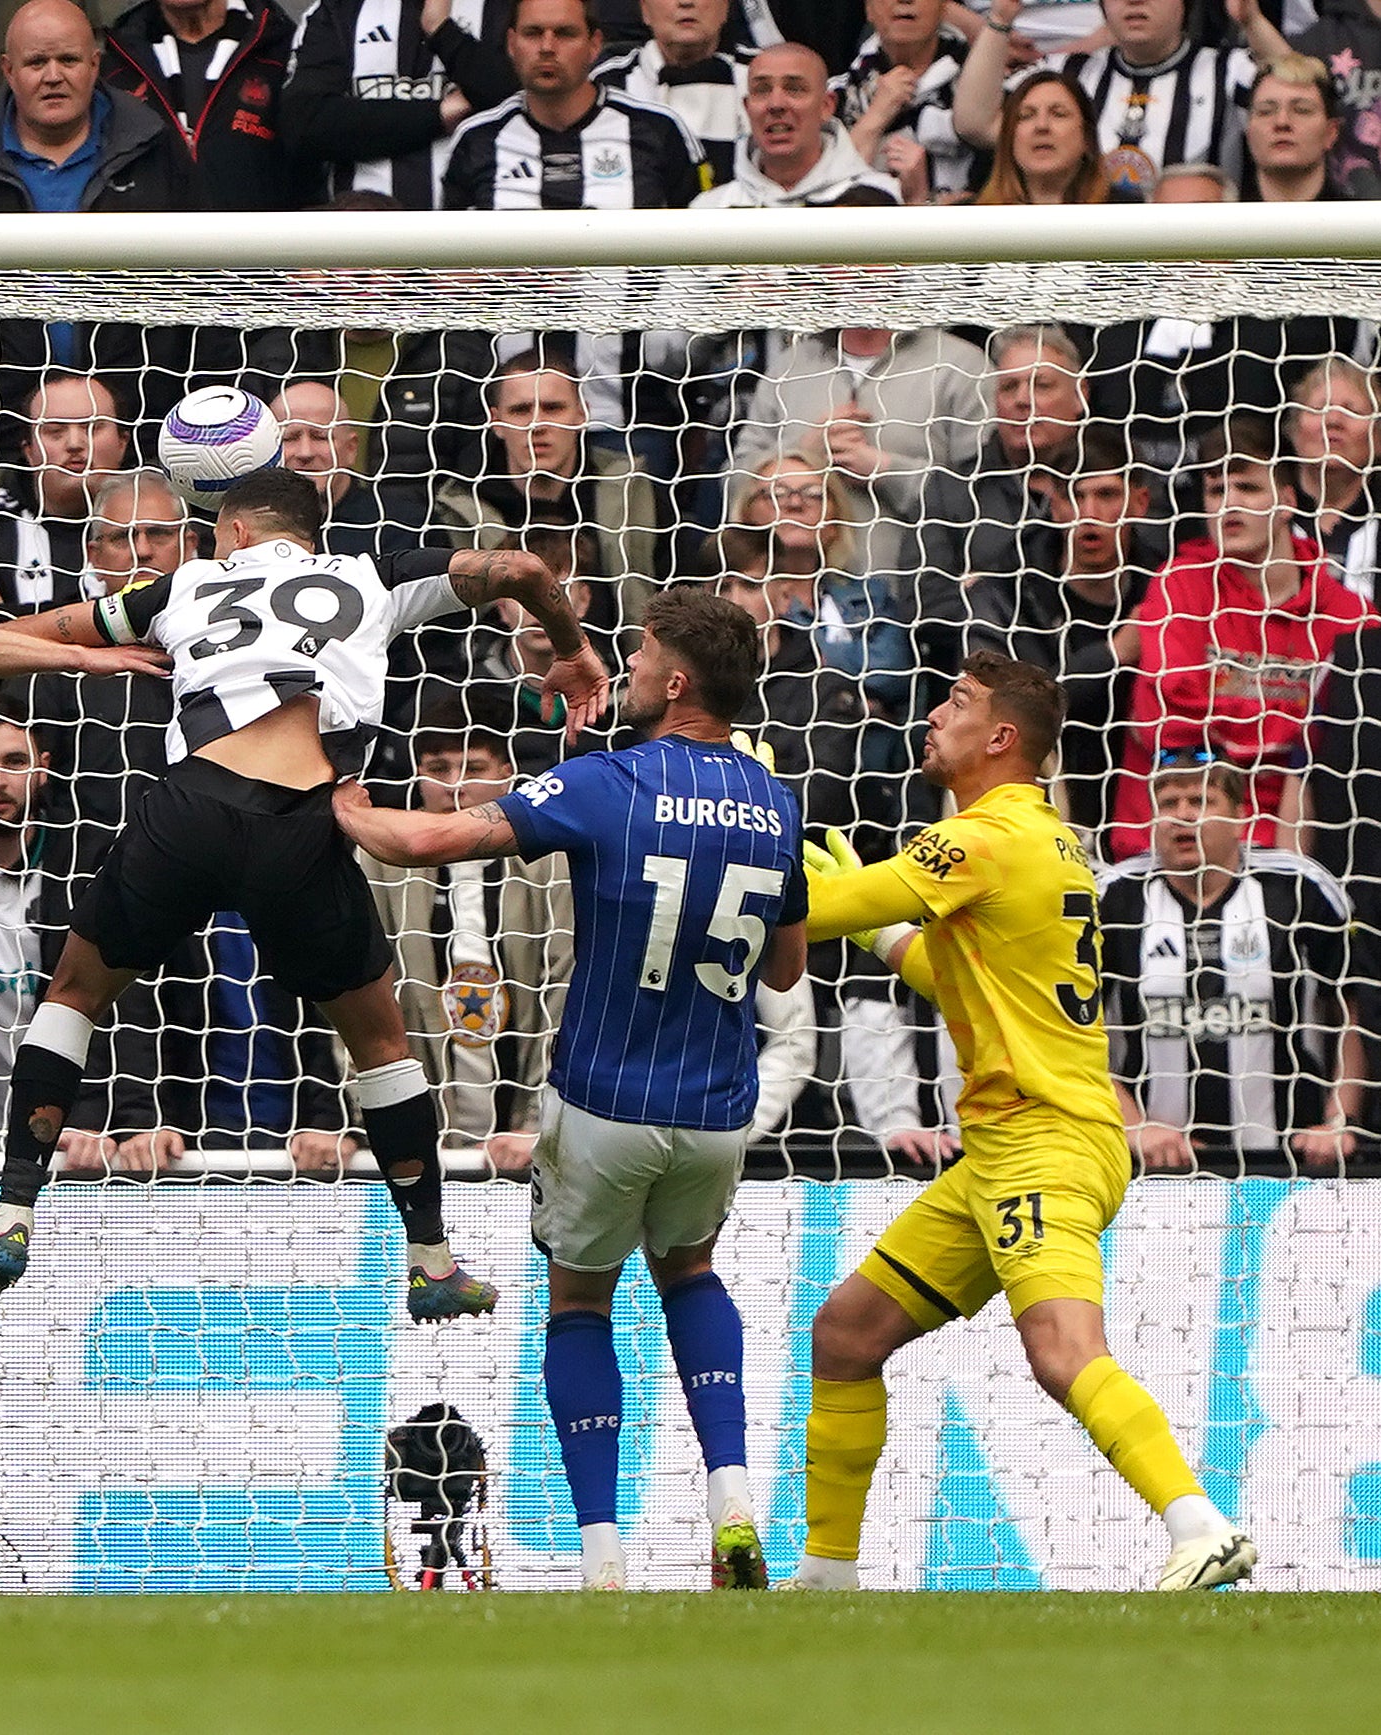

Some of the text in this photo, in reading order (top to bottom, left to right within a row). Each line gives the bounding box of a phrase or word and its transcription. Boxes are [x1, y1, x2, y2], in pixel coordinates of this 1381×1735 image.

[188, 573, 365, 661] 39
[654, 794, 784, 838] BURGESS
[916, 829, 967, 864] HALO
[637, 854, 787, 1004] 15
[1055, 892, 1102, 1027] 3
[995, 1191, 1046, 1250] 31
[690, 1370, 737, 1389] ITFC
[568, 1413, 619, 1434] ITFC
